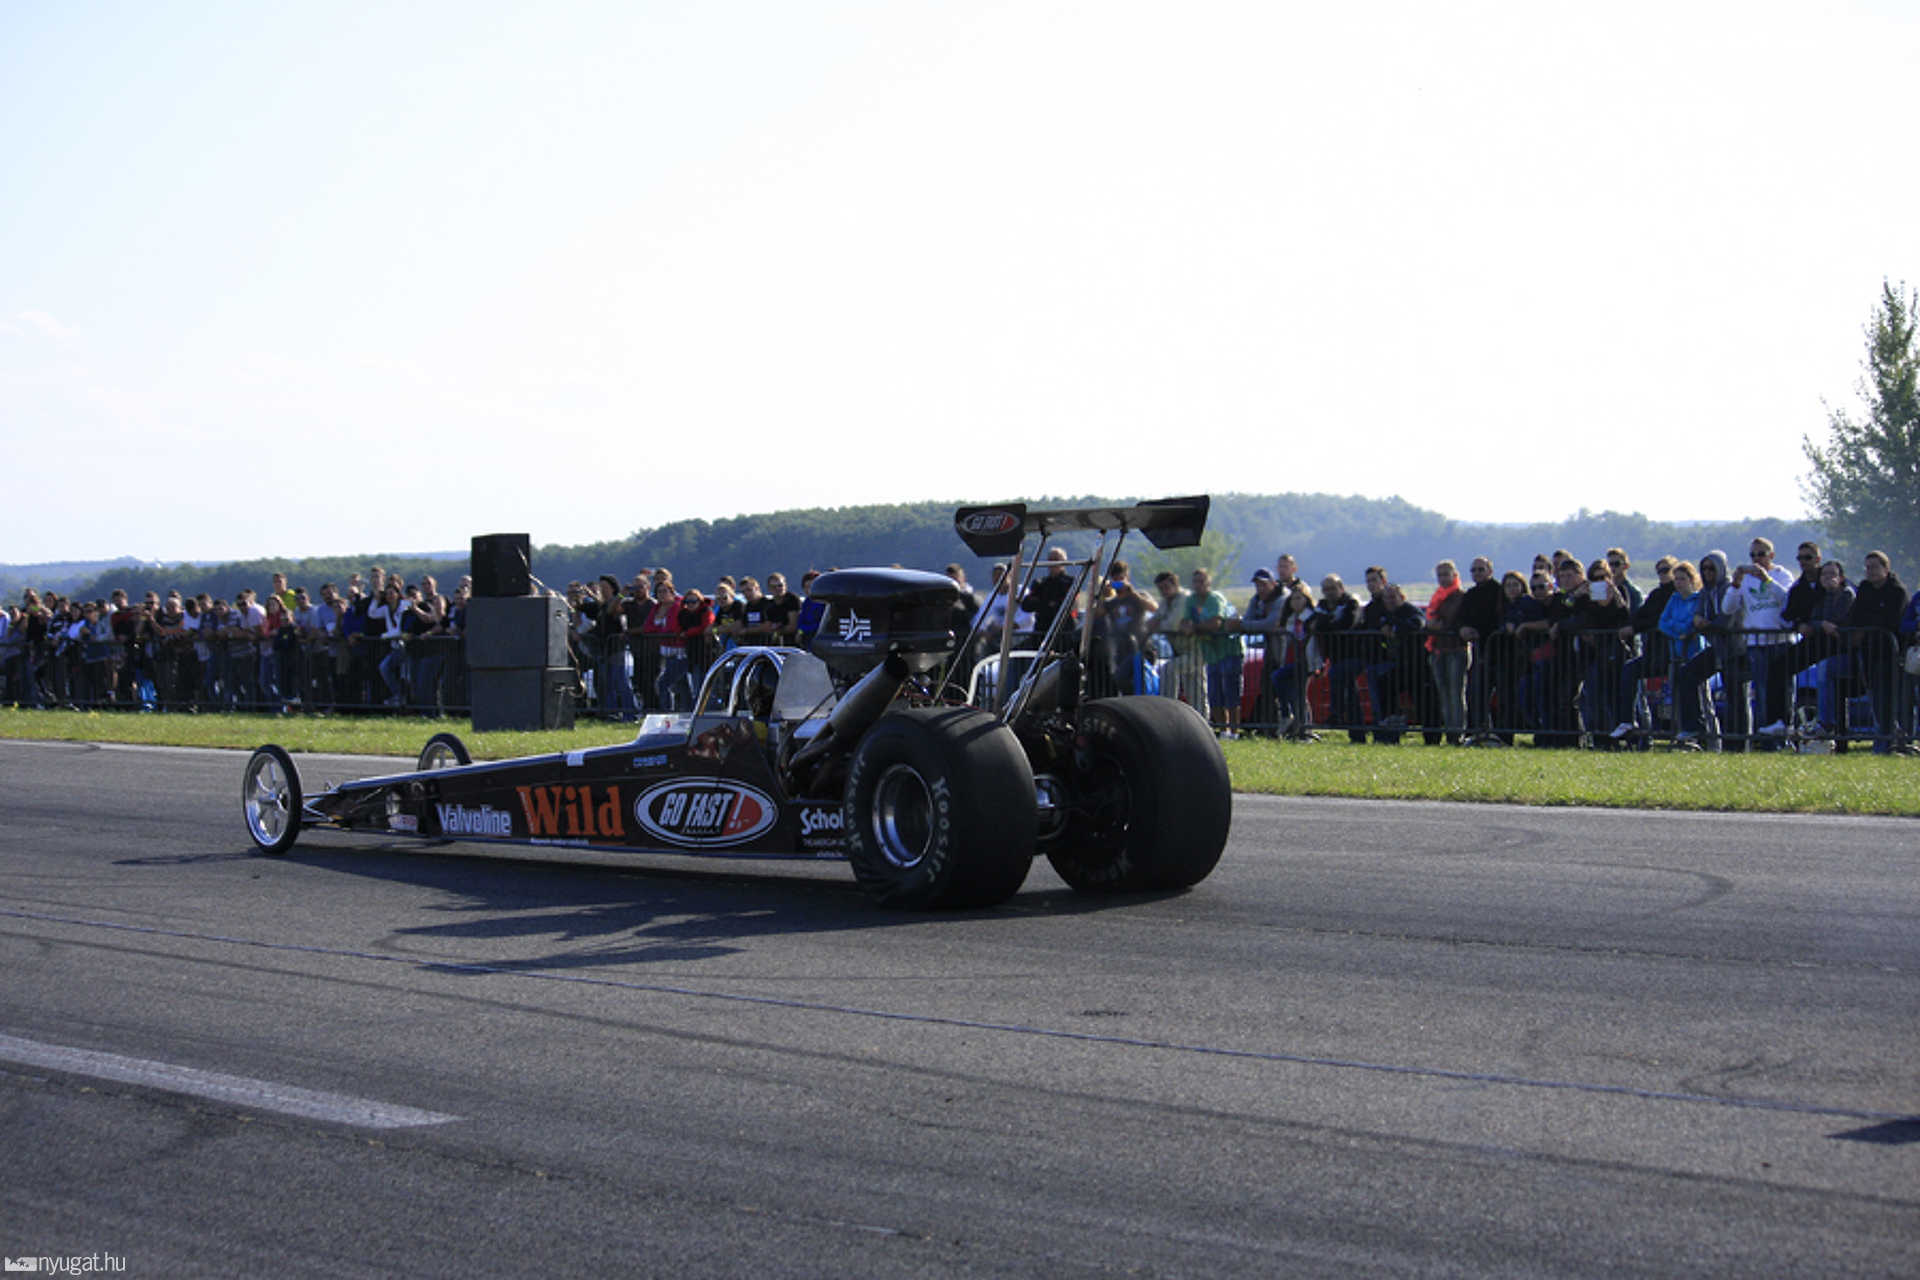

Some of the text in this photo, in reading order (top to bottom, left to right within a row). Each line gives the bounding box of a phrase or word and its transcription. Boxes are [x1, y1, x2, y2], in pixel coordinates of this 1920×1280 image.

[434, 802, 513, 836] Valvoline
[514, 784, 625, 837] Wild
[657, 792, 688, 827] GO
